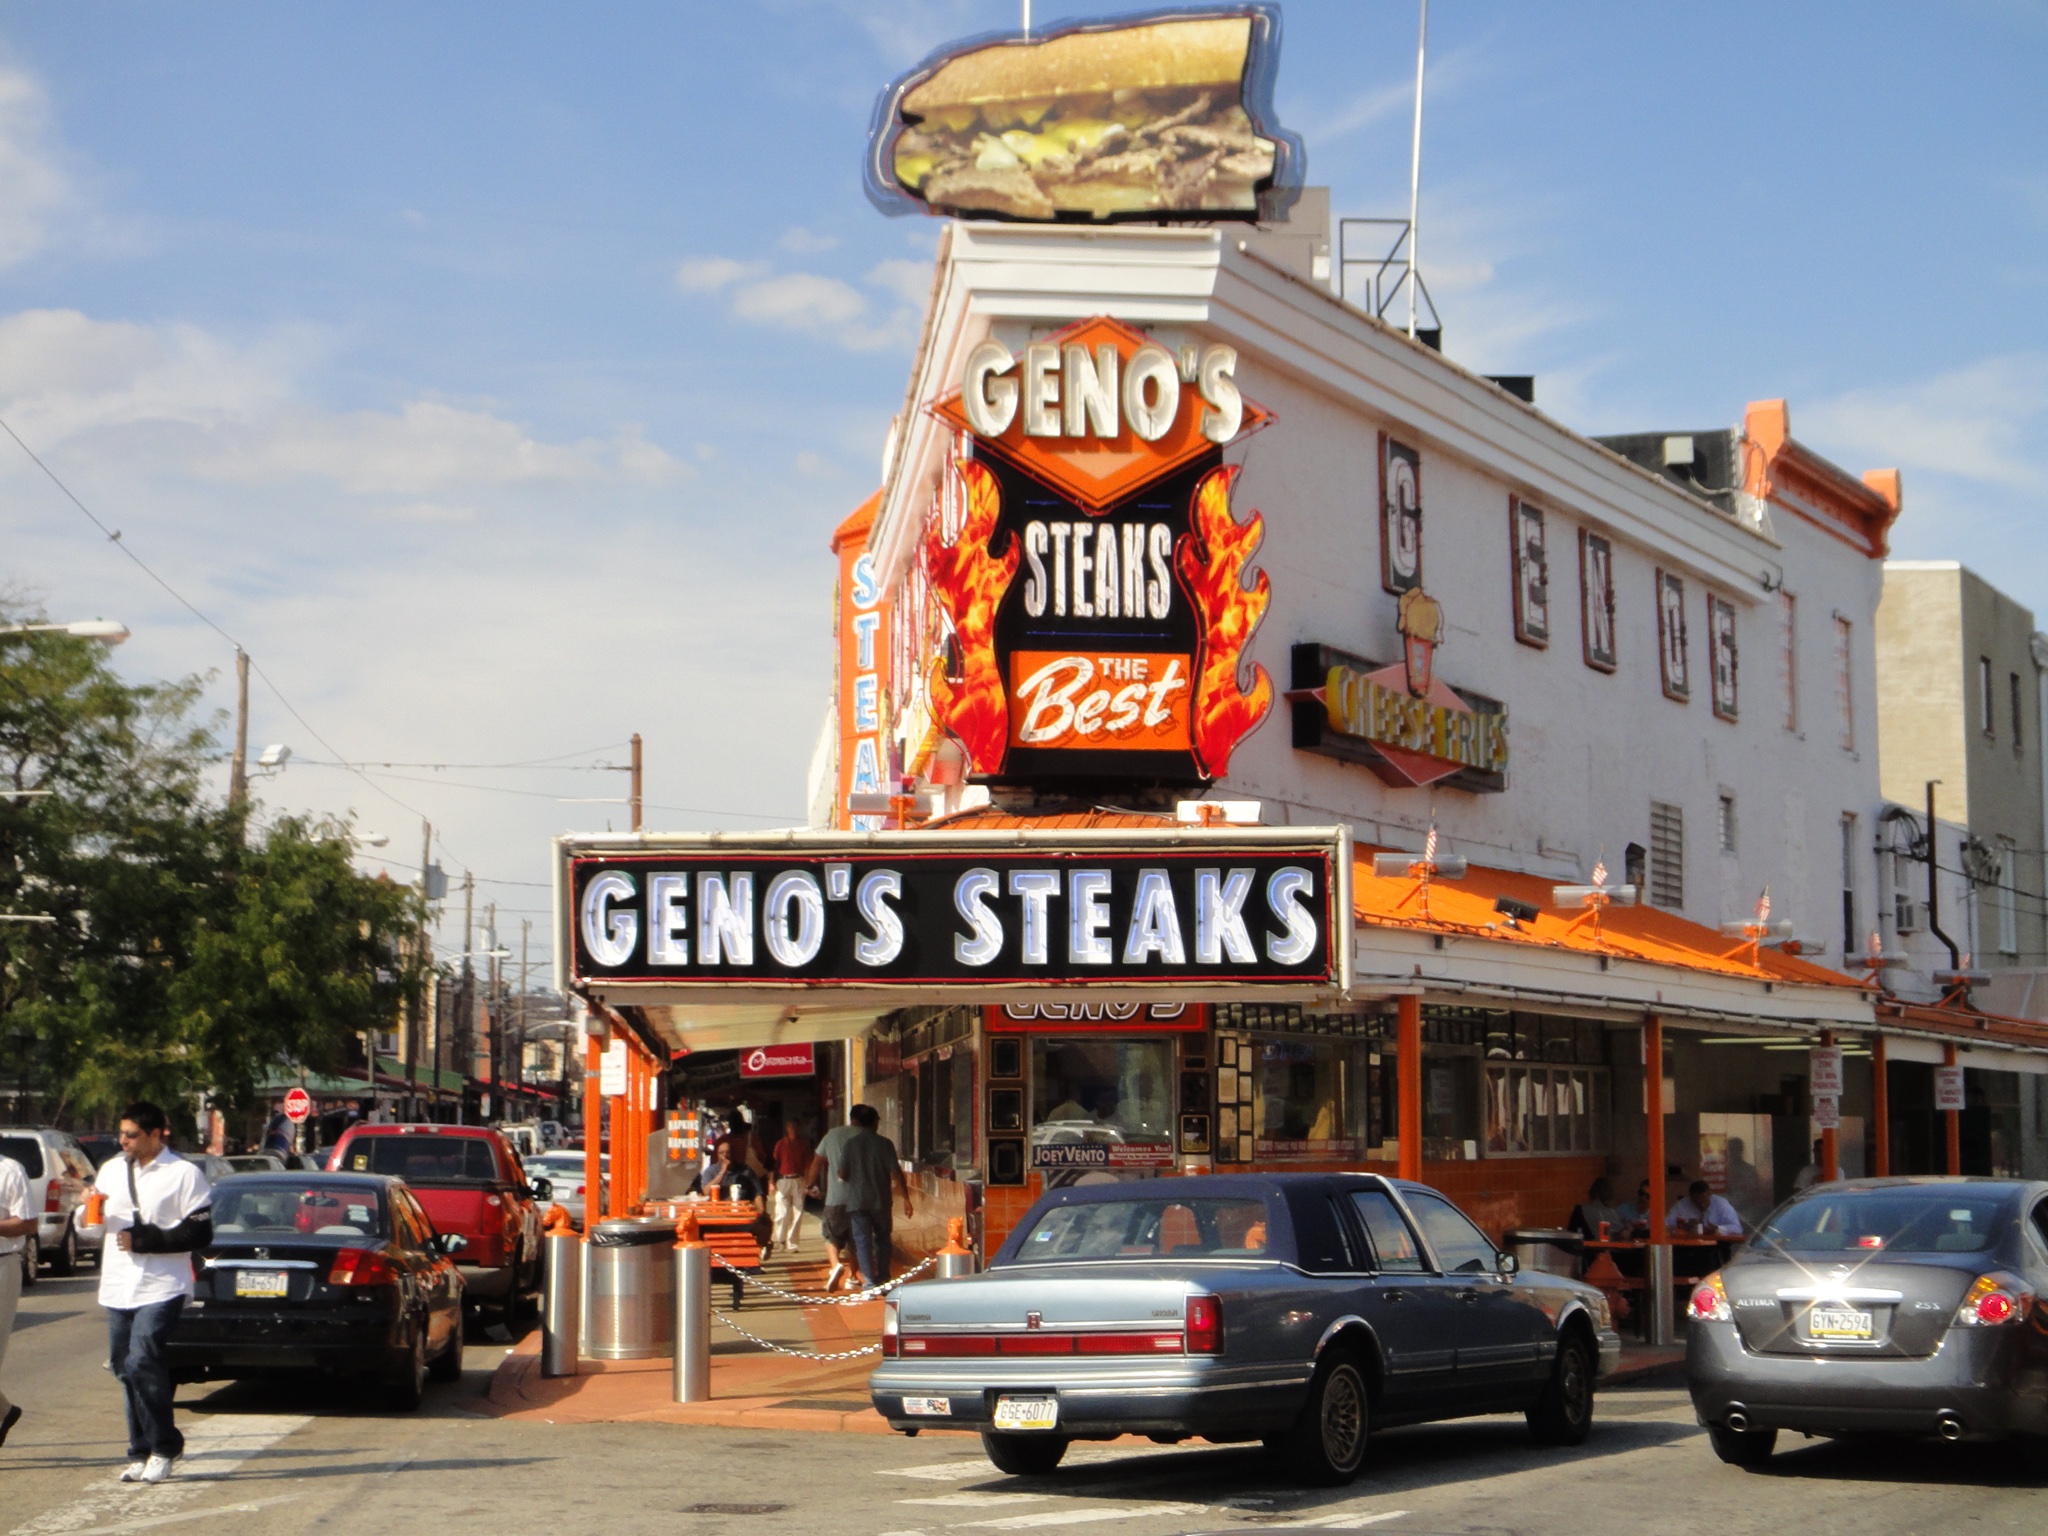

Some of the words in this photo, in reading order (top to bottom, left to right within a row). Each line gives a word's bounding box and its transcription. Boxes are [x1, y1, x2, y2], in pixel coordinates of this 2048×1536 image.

[961, 340, 1243, 443] GENO'S
[1024, 520, 1172, 620] STEAKS
[1098, 658, 1149, 681] THE
[1017, 656, 1187, 743] Best
[1329, 665, 1437, 756] CHEESE
[581, 862, 904, 967] GENO'S
[953, 867, 1318, 968] STEAKS
[285, 1099, 310, 1113] STOP
[668, 1120, 699, 1131] NAPKINS
[668, 1137, 699, 1149] NAPKINS
[1154, 1144, 1172, 1153] You!
[1034, 1146, 1065, 1165] JOEY
[1064, 1146, 1106, 1163] VENTO
[1737, 1299, 1775, 1307] ALTIMA
